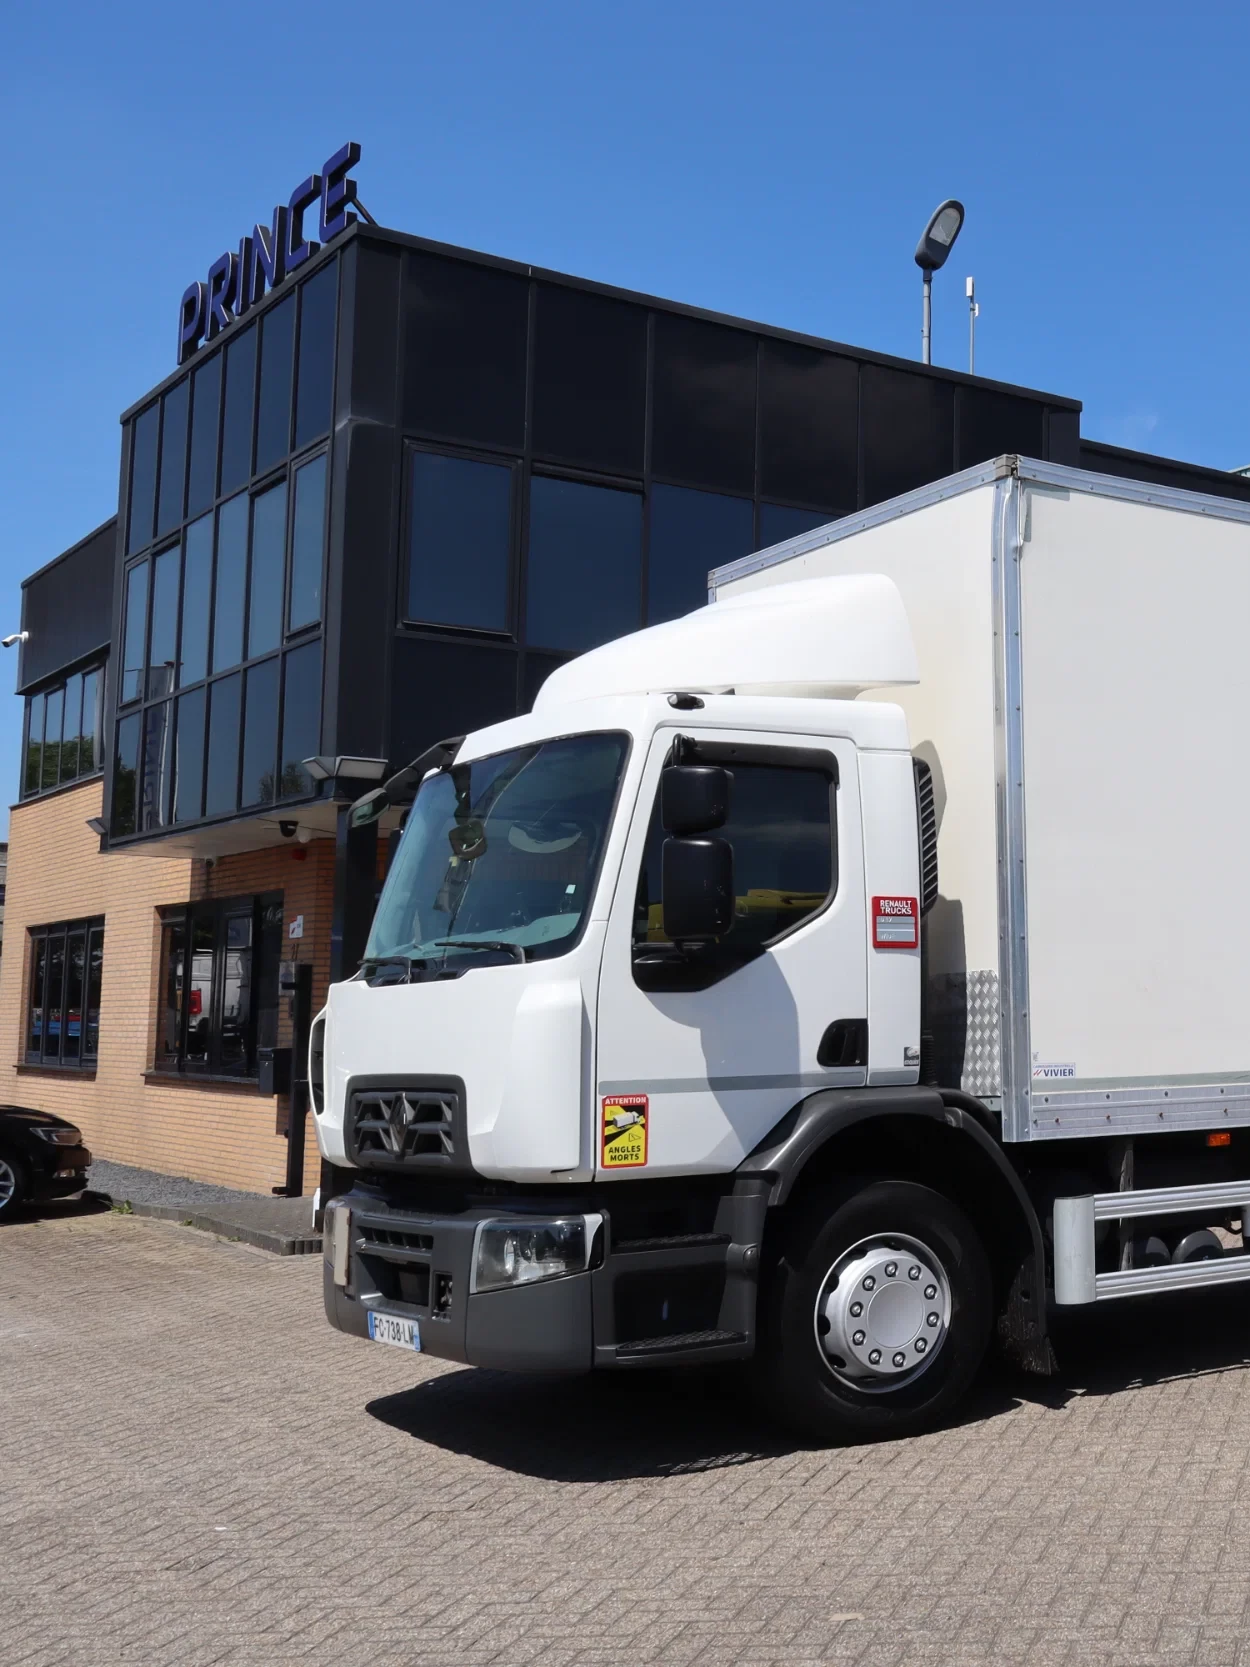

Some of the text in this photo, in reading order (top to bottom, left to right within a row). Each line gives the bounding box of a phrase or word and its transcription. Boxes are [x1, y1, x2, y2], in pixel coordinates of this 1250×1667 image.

[177, 141, 361, 365] PRINCE
[880, 900, 912, 908] RENAULT
[880, 906, 912, 915] TRUCKS
[1043, 1068, 1074, 1077] VIVIER
[604, 1096, 647, 1105] ATTENTION
[608, 1145, 641, 1154] ANGLES
[610, 1153, 640, 1162] MORTS
